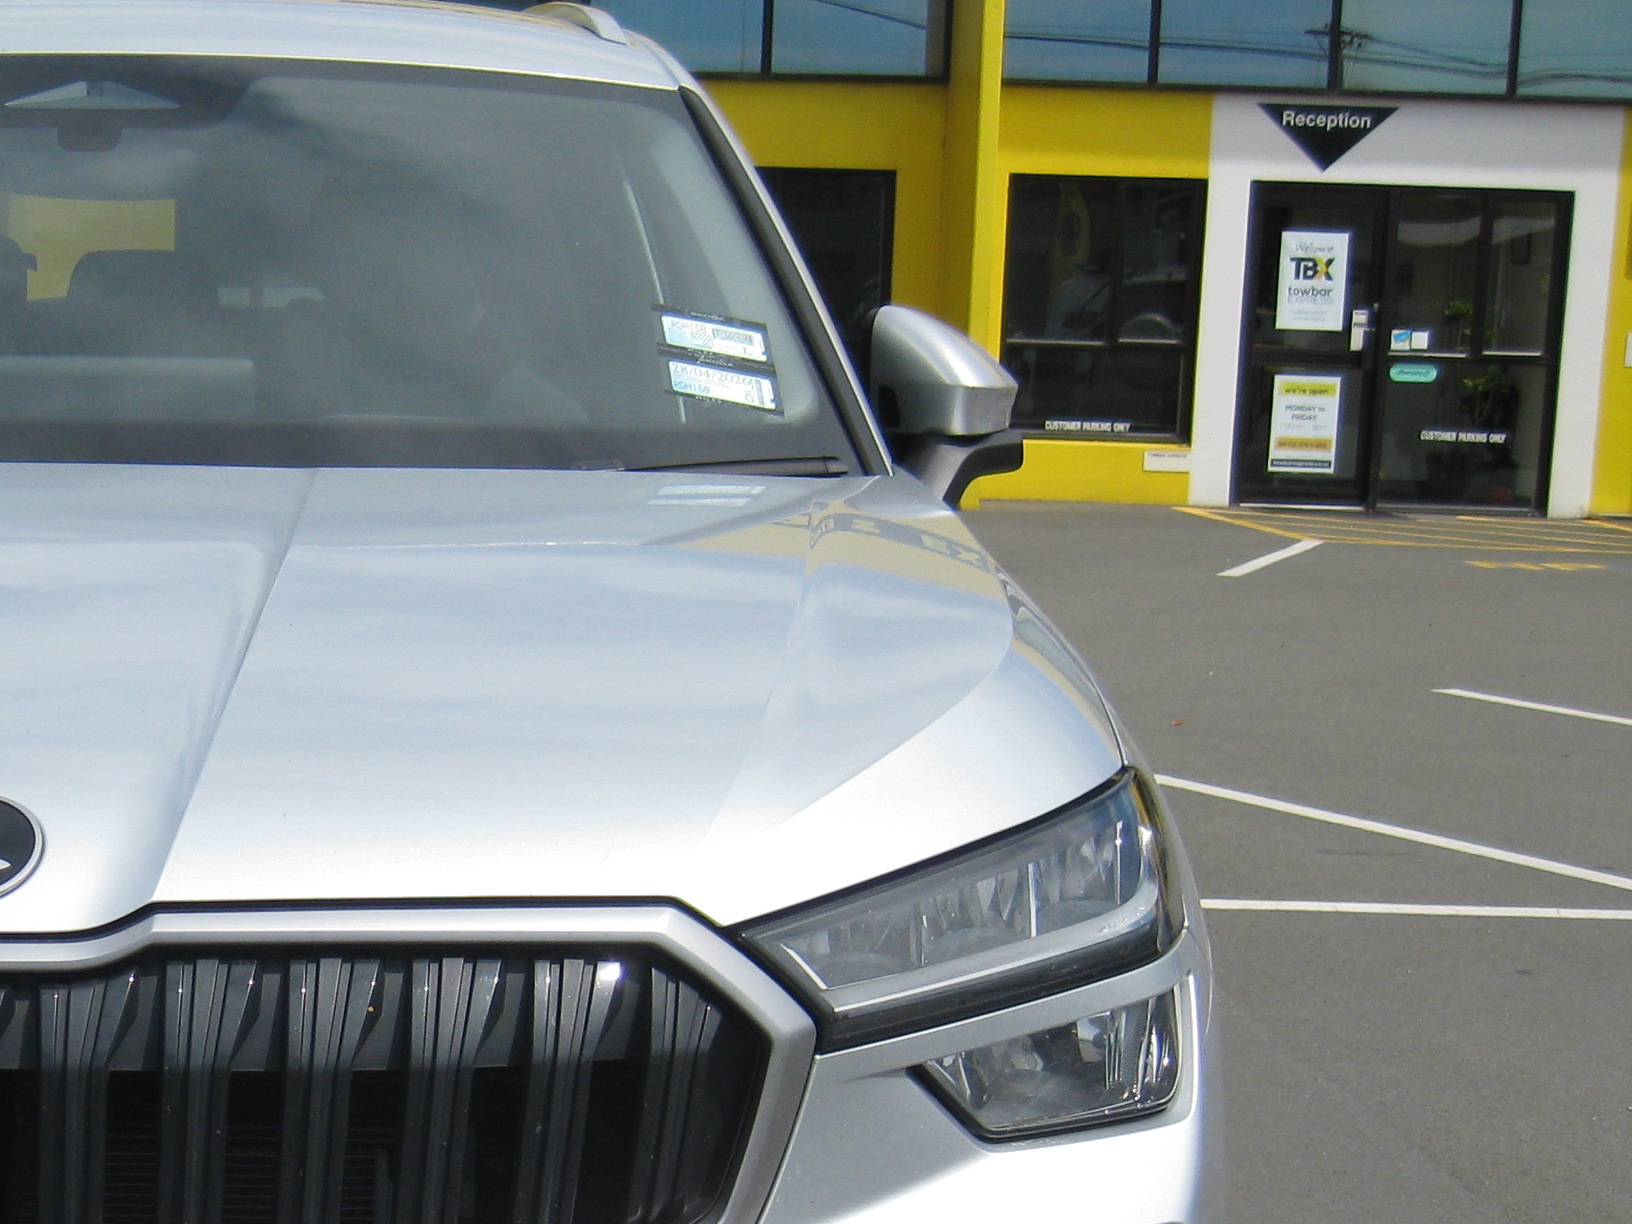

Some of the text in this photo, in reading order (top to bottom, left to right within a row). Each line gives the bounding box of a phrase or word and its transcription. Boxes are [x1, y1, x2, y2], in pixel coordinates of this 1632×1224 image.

[1282, 110, 1372, 132] Reception
[1289, 257, 1336, 281] TBX
[1288, 286, 1333, 297] towbar
[1045, 420, 1081, 431] CUSTOMER
